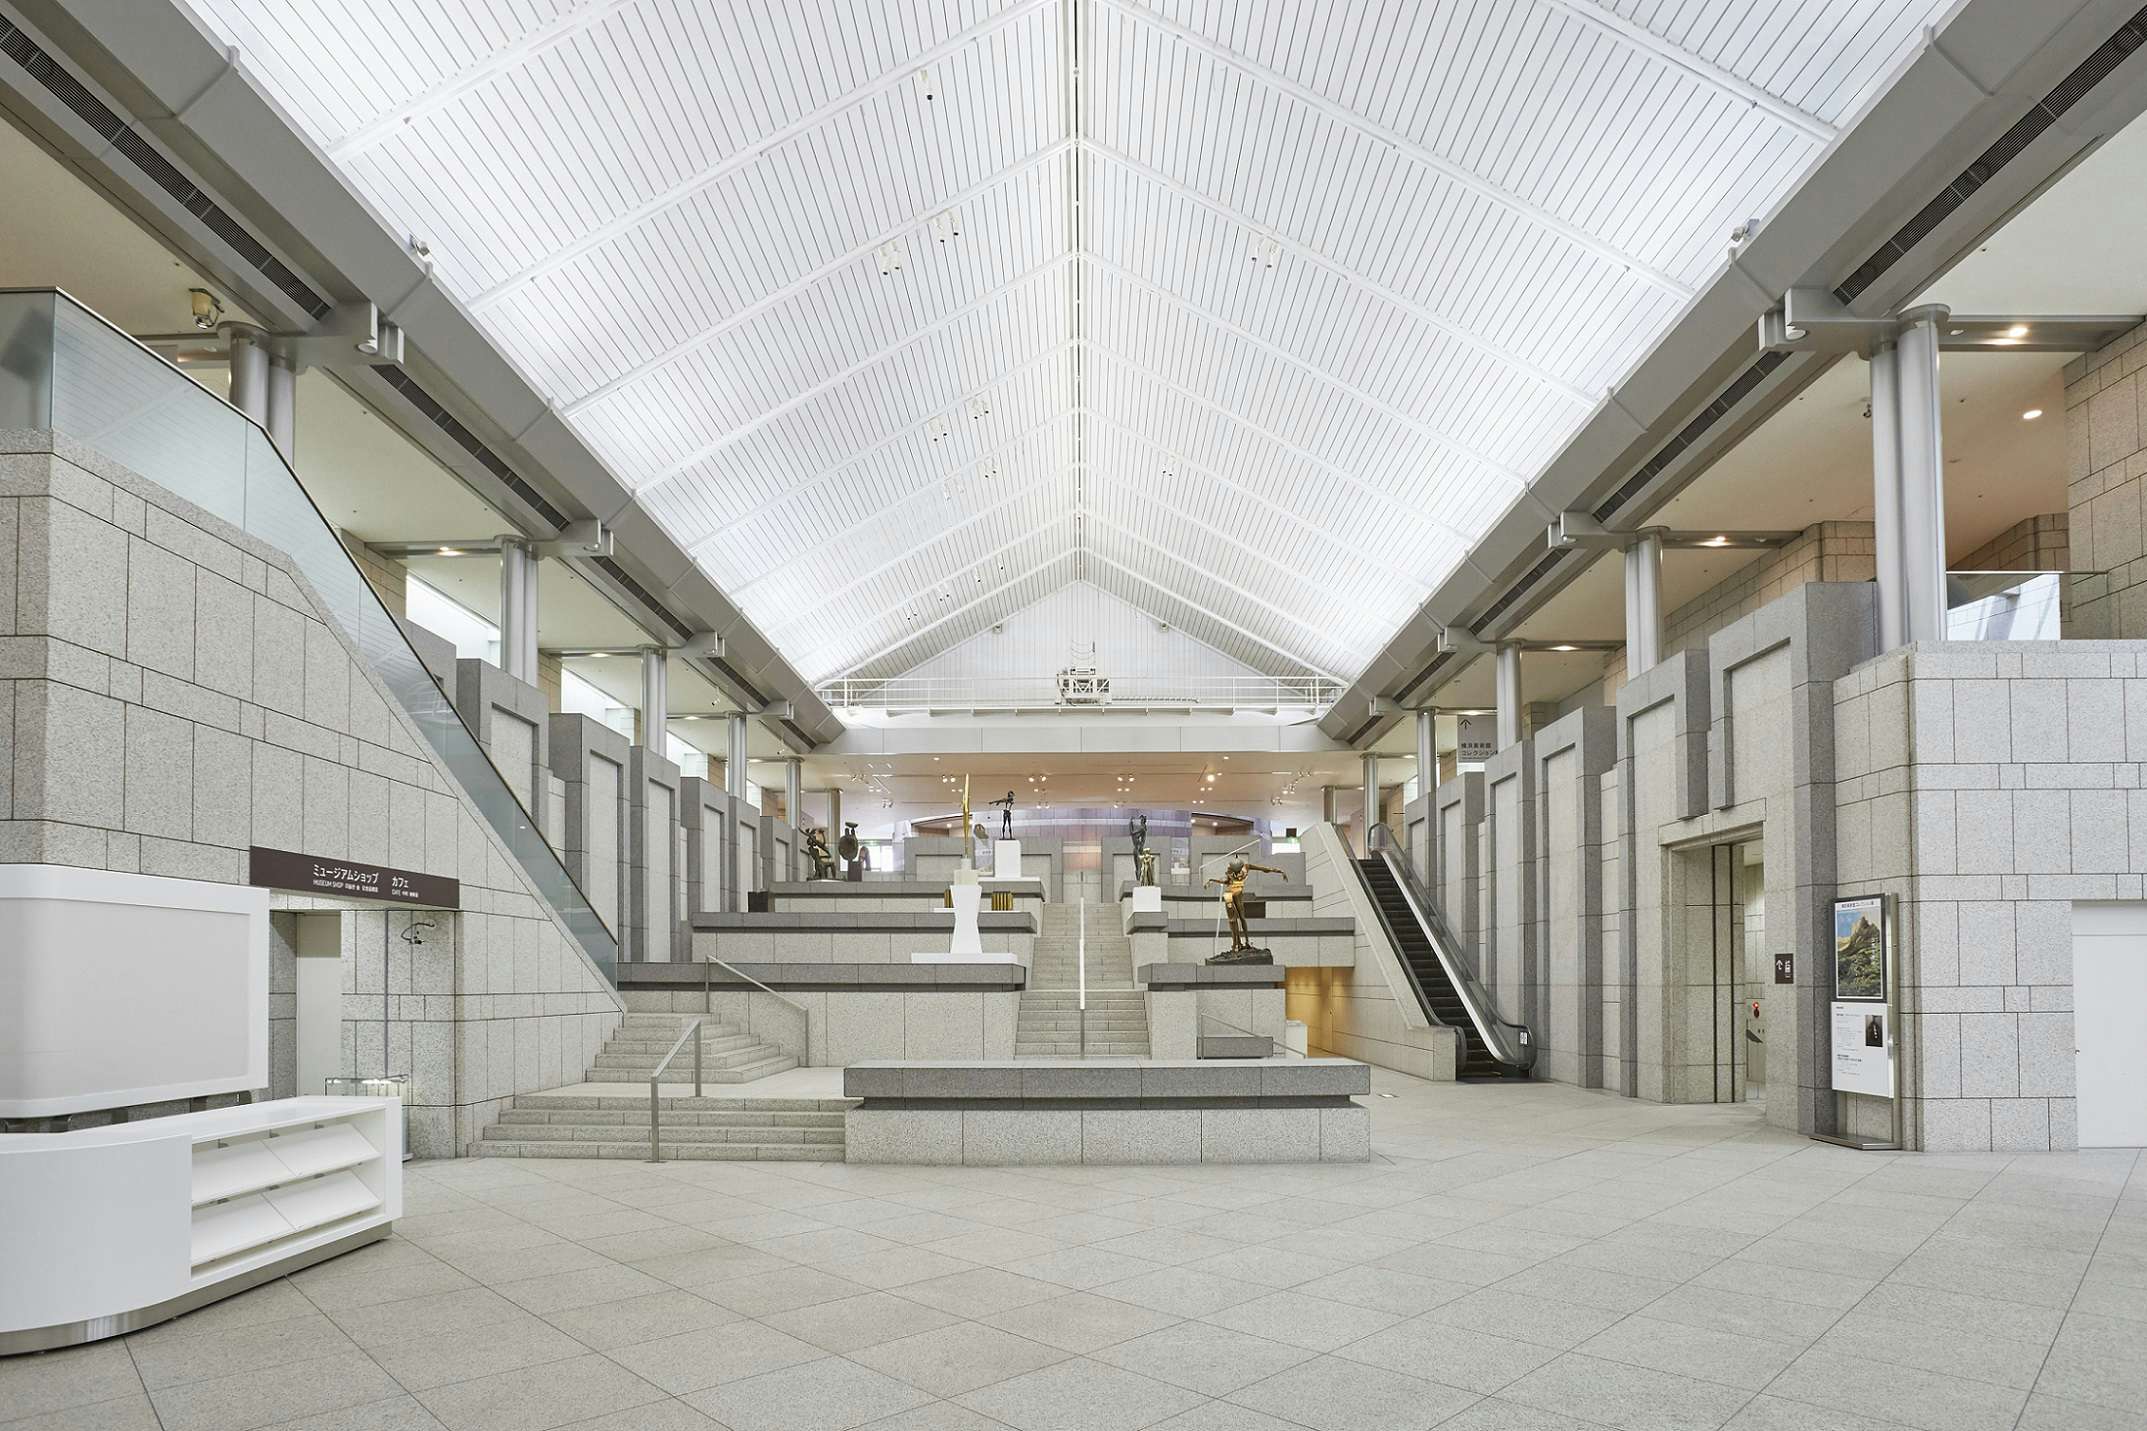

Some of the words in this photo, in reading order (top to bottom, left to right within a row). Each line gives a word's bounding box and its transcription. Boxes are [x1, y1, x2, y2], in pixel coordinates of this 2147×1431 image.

[313, 864, 379, 884] ミュージアムショップ
[392, 876, 409, 888] カフェ
